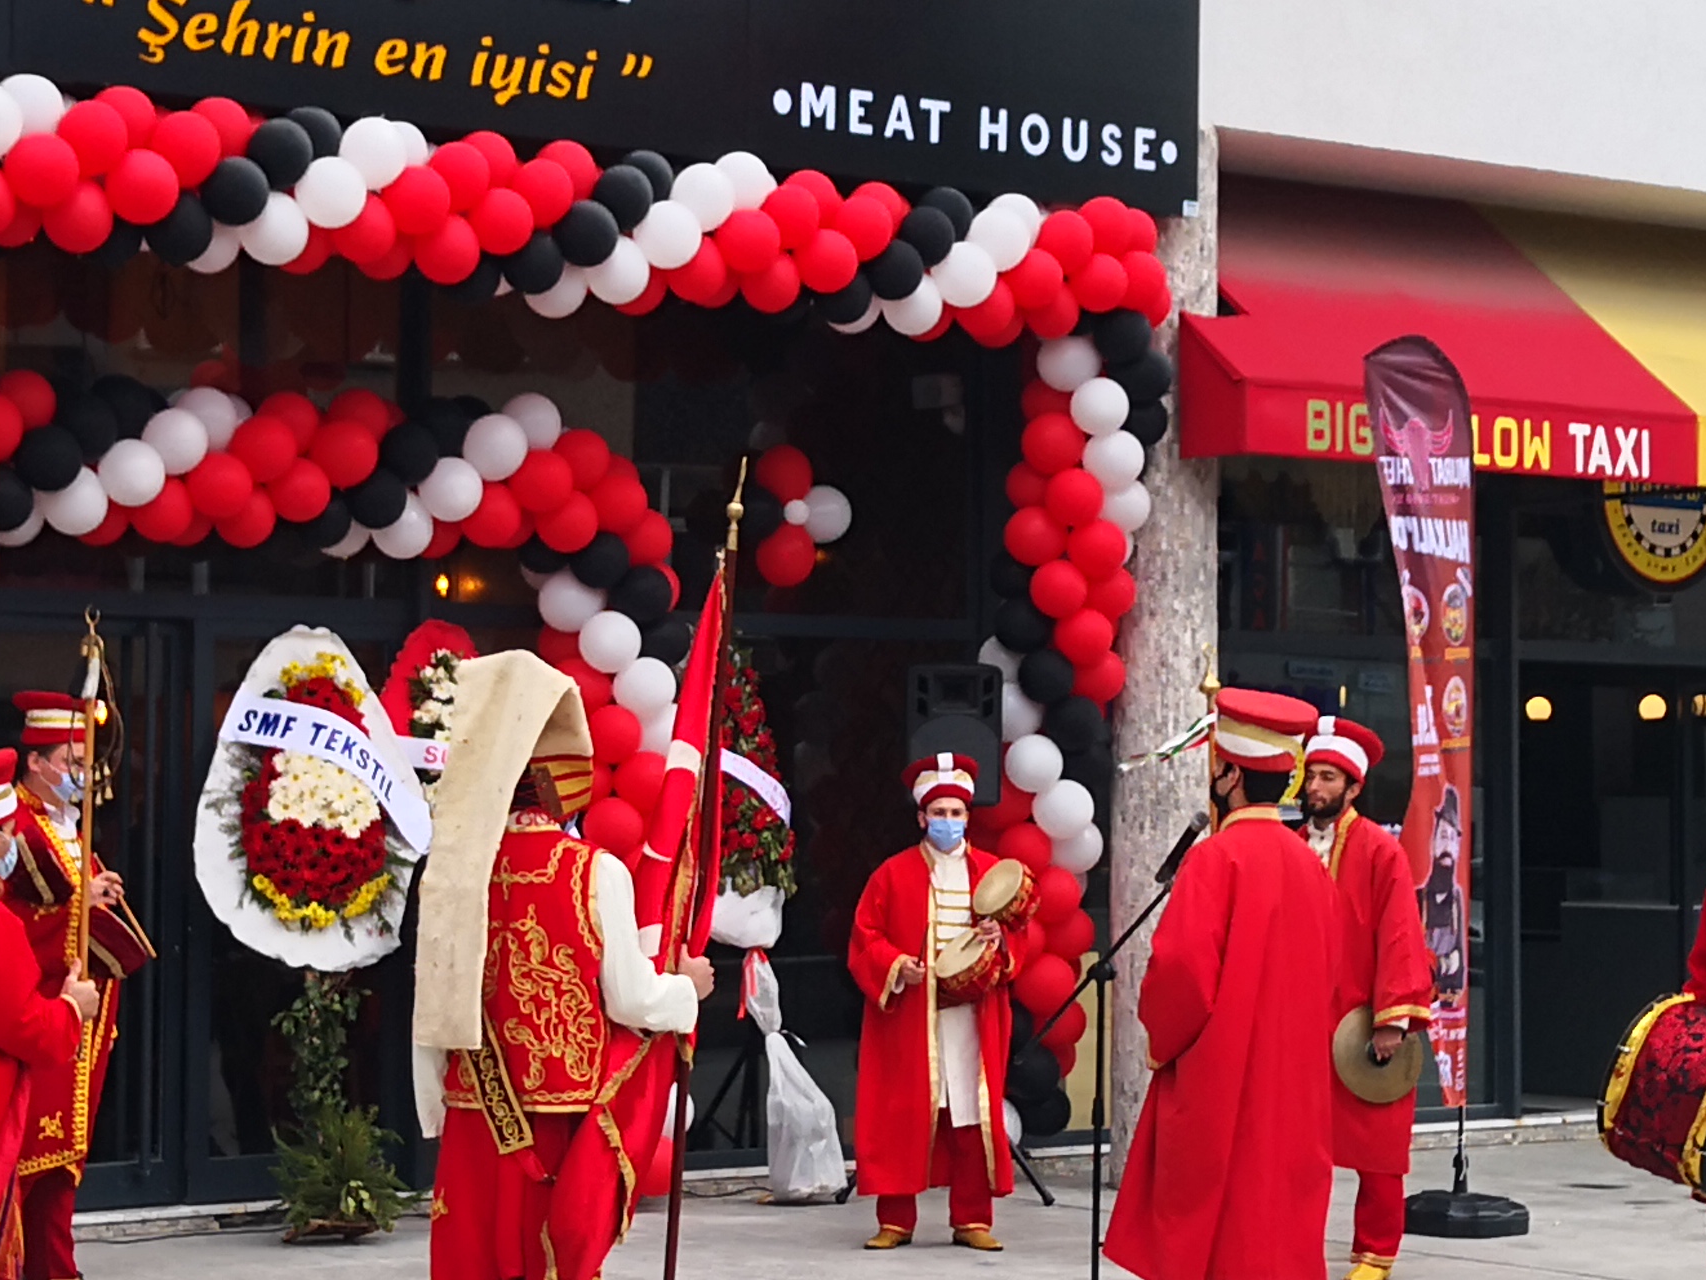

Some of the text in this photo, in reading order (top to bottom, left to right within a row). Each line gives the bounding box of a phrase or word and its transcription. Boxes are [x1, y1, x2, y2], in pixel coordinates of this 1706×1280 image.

[373, 35, 447, 84] en
[469, 33, 599, 108] iyisi
[798, 83, 1159, 174] MEAT HOUSE
[1306, 399, 1374, 455] BIG
[1568, 422, 1651, 480] TAXI
[1651, 519, 1681, 535] taxi
[237, 709, 298, 740] SMF
